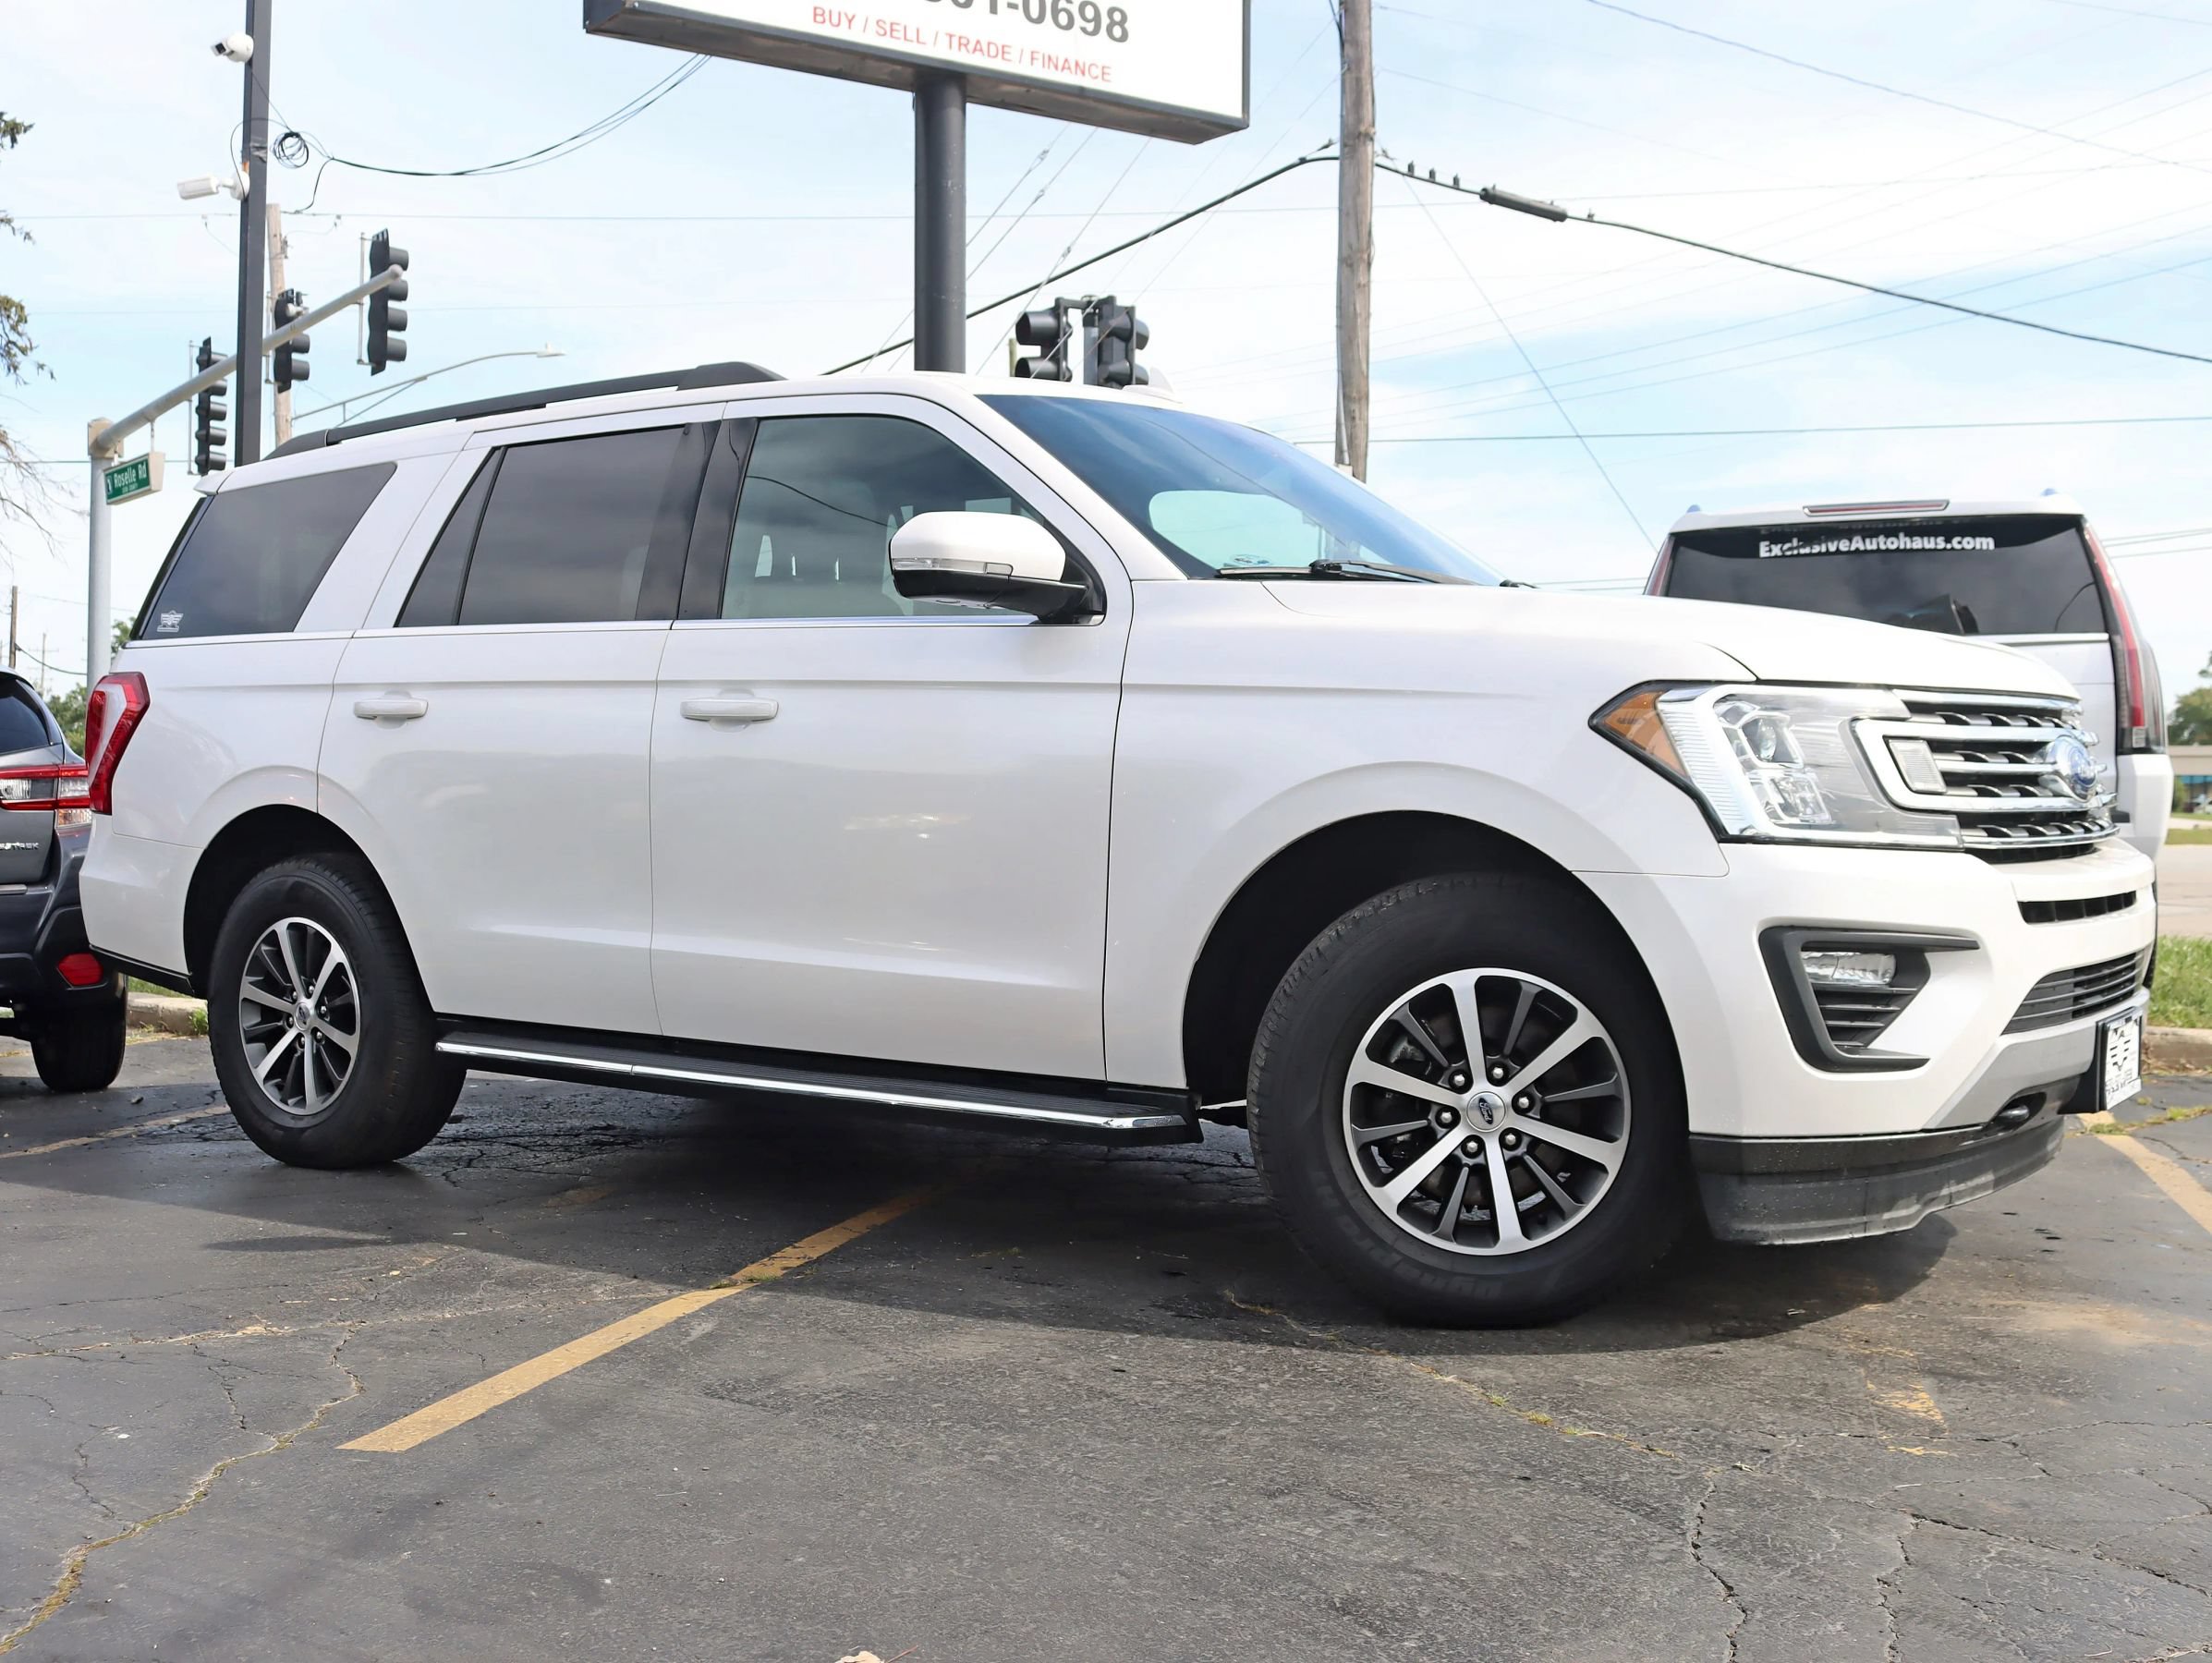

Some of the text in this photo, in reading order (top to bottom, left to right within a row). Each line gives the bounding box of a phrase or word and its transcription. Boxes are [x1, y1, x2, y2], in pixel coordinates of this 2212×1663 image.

[927, 0, 1129, 42] -0698
[813, 6, 856, 30] BUY
[875, 18, 927, 45] SELL
[945, 32, 1013, 62] TRADE
[1030, 50, 1112, 82] FINANCE
[114, 462, 147, 488] Roselle Rd
